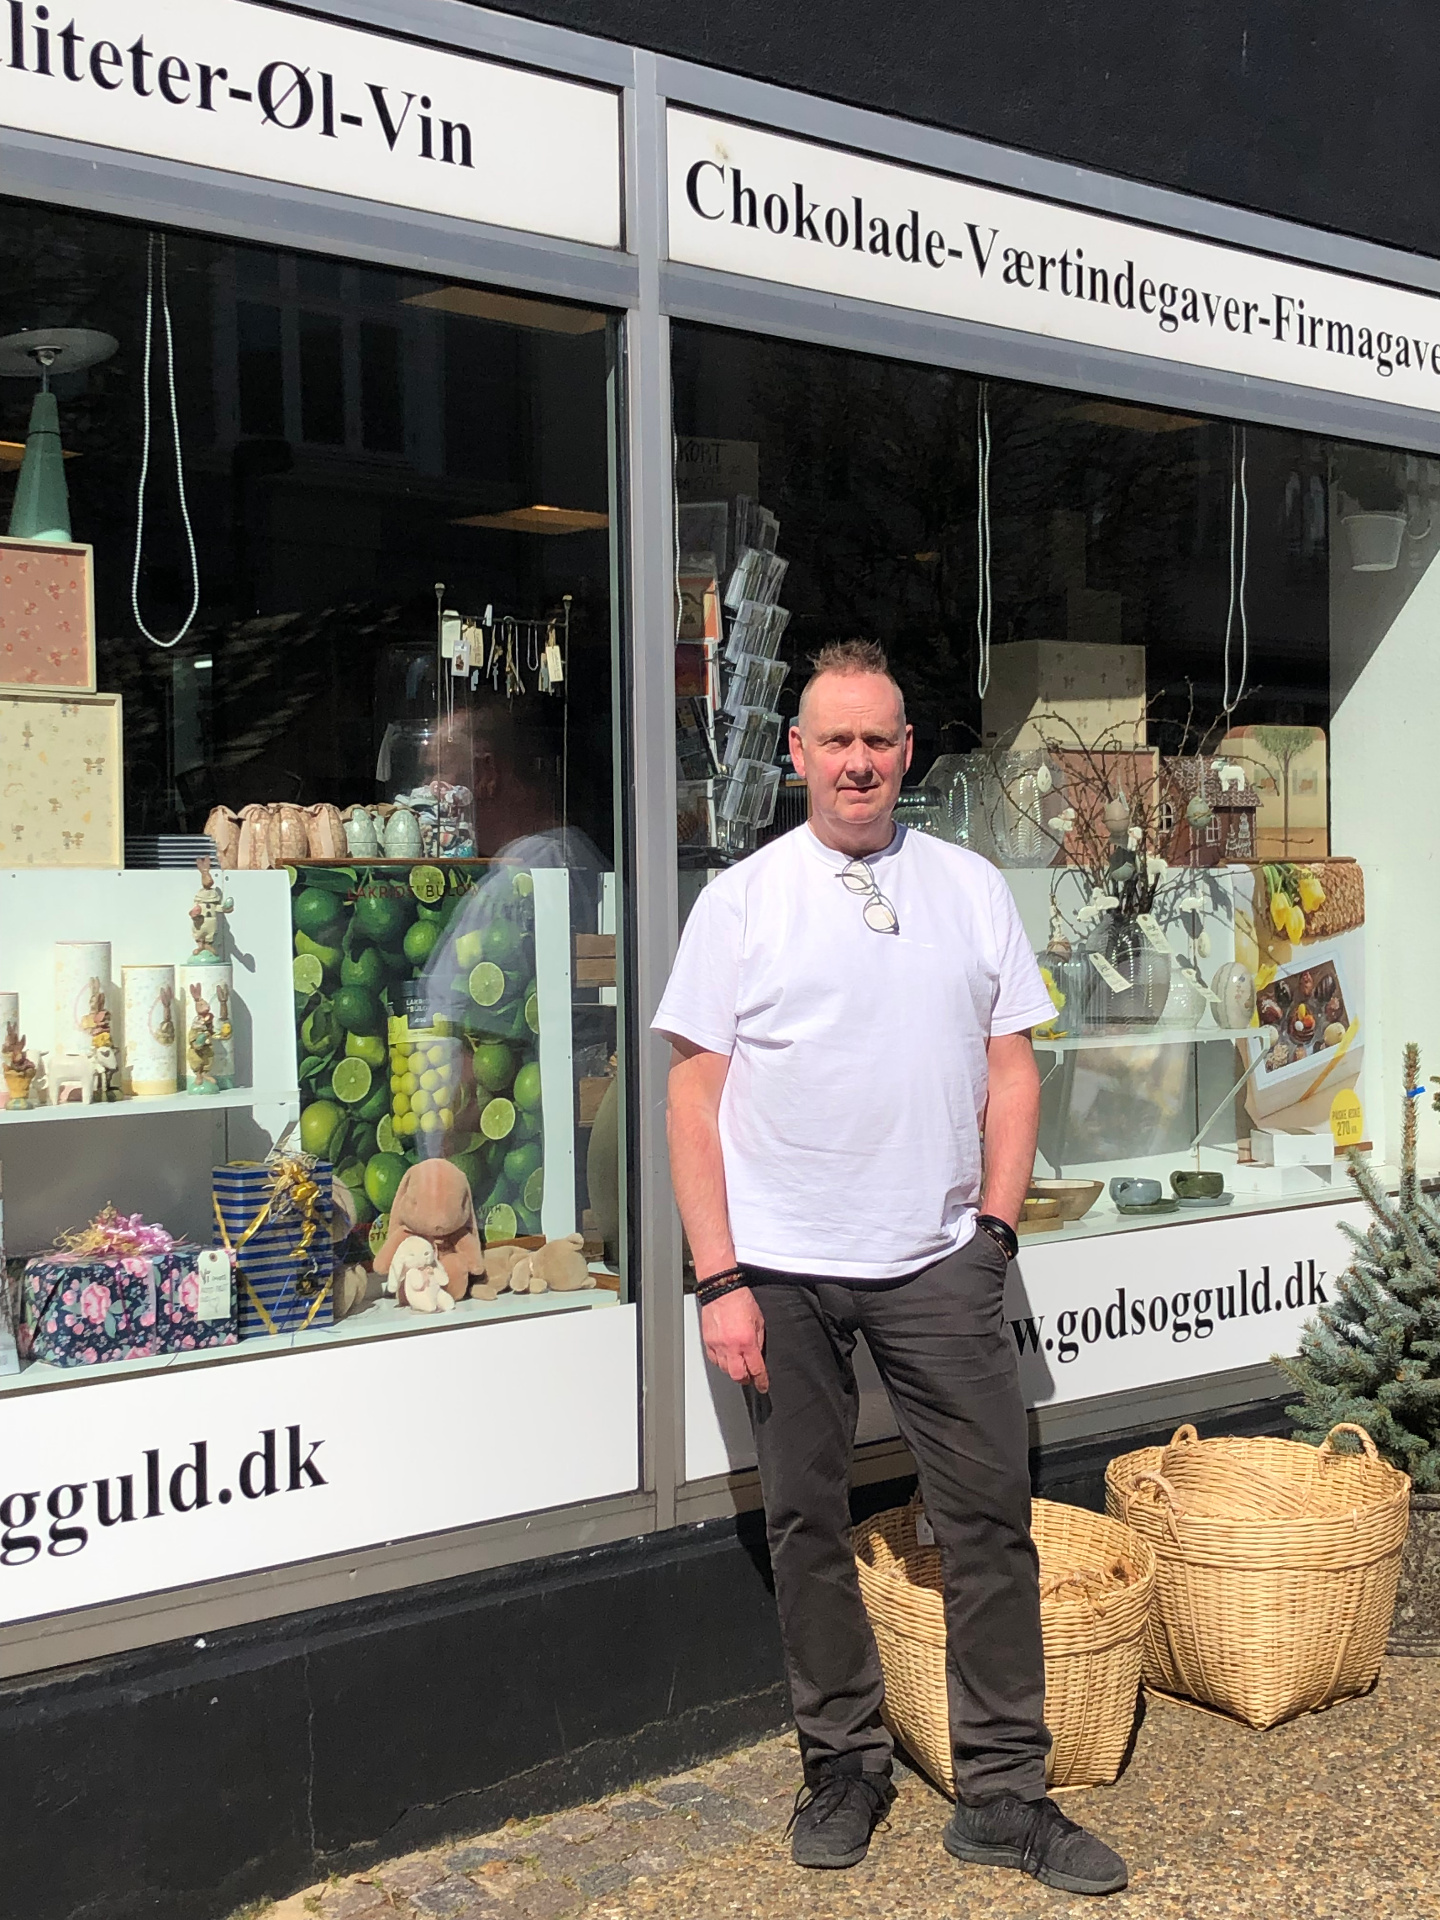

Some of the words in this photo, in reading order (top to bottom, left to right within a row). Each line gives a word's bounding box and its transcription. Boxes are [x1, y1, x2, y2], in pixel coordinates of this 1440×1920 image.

[0, 0, 475, 168] liteter-Øl-Vin
[686, 160, 1440, 378] Chokolade-Værtindegaver-Firmagave
[1337, 1120, 1351, 1136] 270
[1006, 1258, 1330, 1365] w.godsogguld.dk
[0, 1424, 329, 1566] gguld.dk
